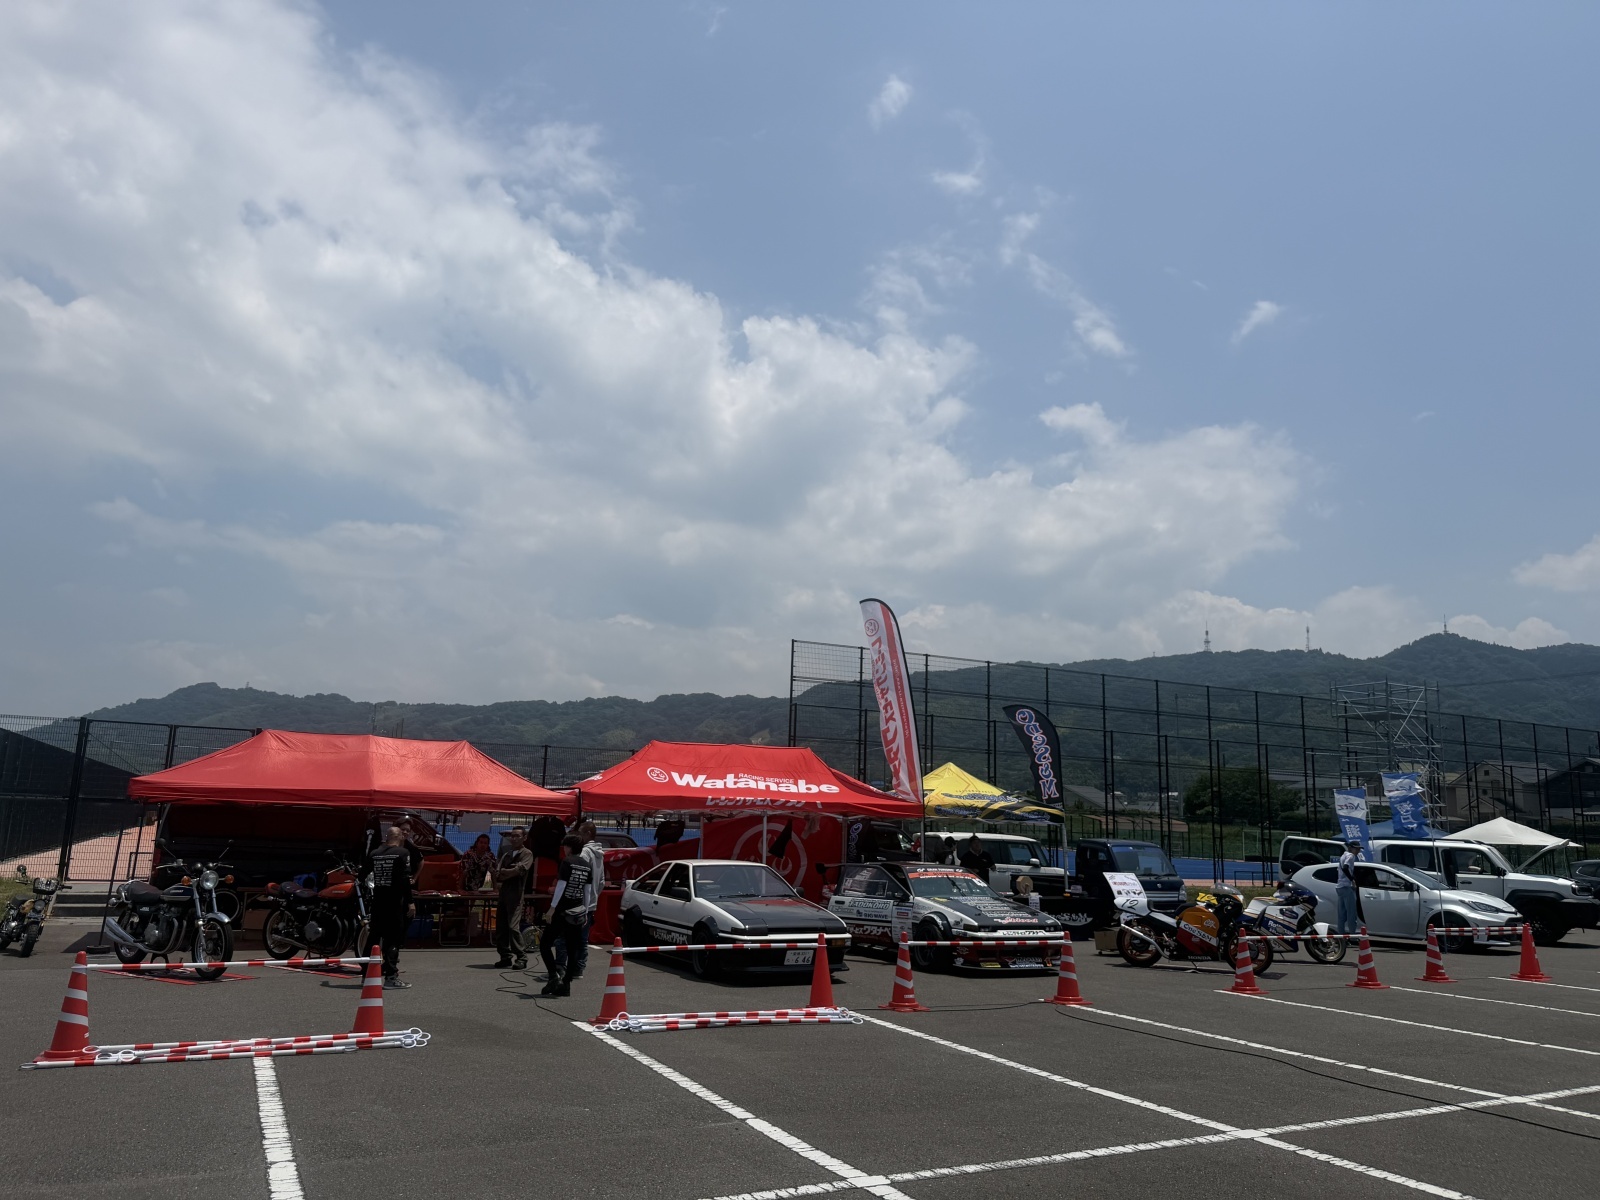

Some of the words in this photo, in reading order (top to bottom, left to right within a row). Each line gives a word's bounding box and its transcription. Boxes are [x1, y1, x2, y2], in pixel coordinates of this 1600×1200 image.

[670, 771, 840, 794] Watanabe
[738, 773, 764, 781] RACING
[765, 776, 794, 784] SERVICE
[1121, 898, 1138, 910] 12
